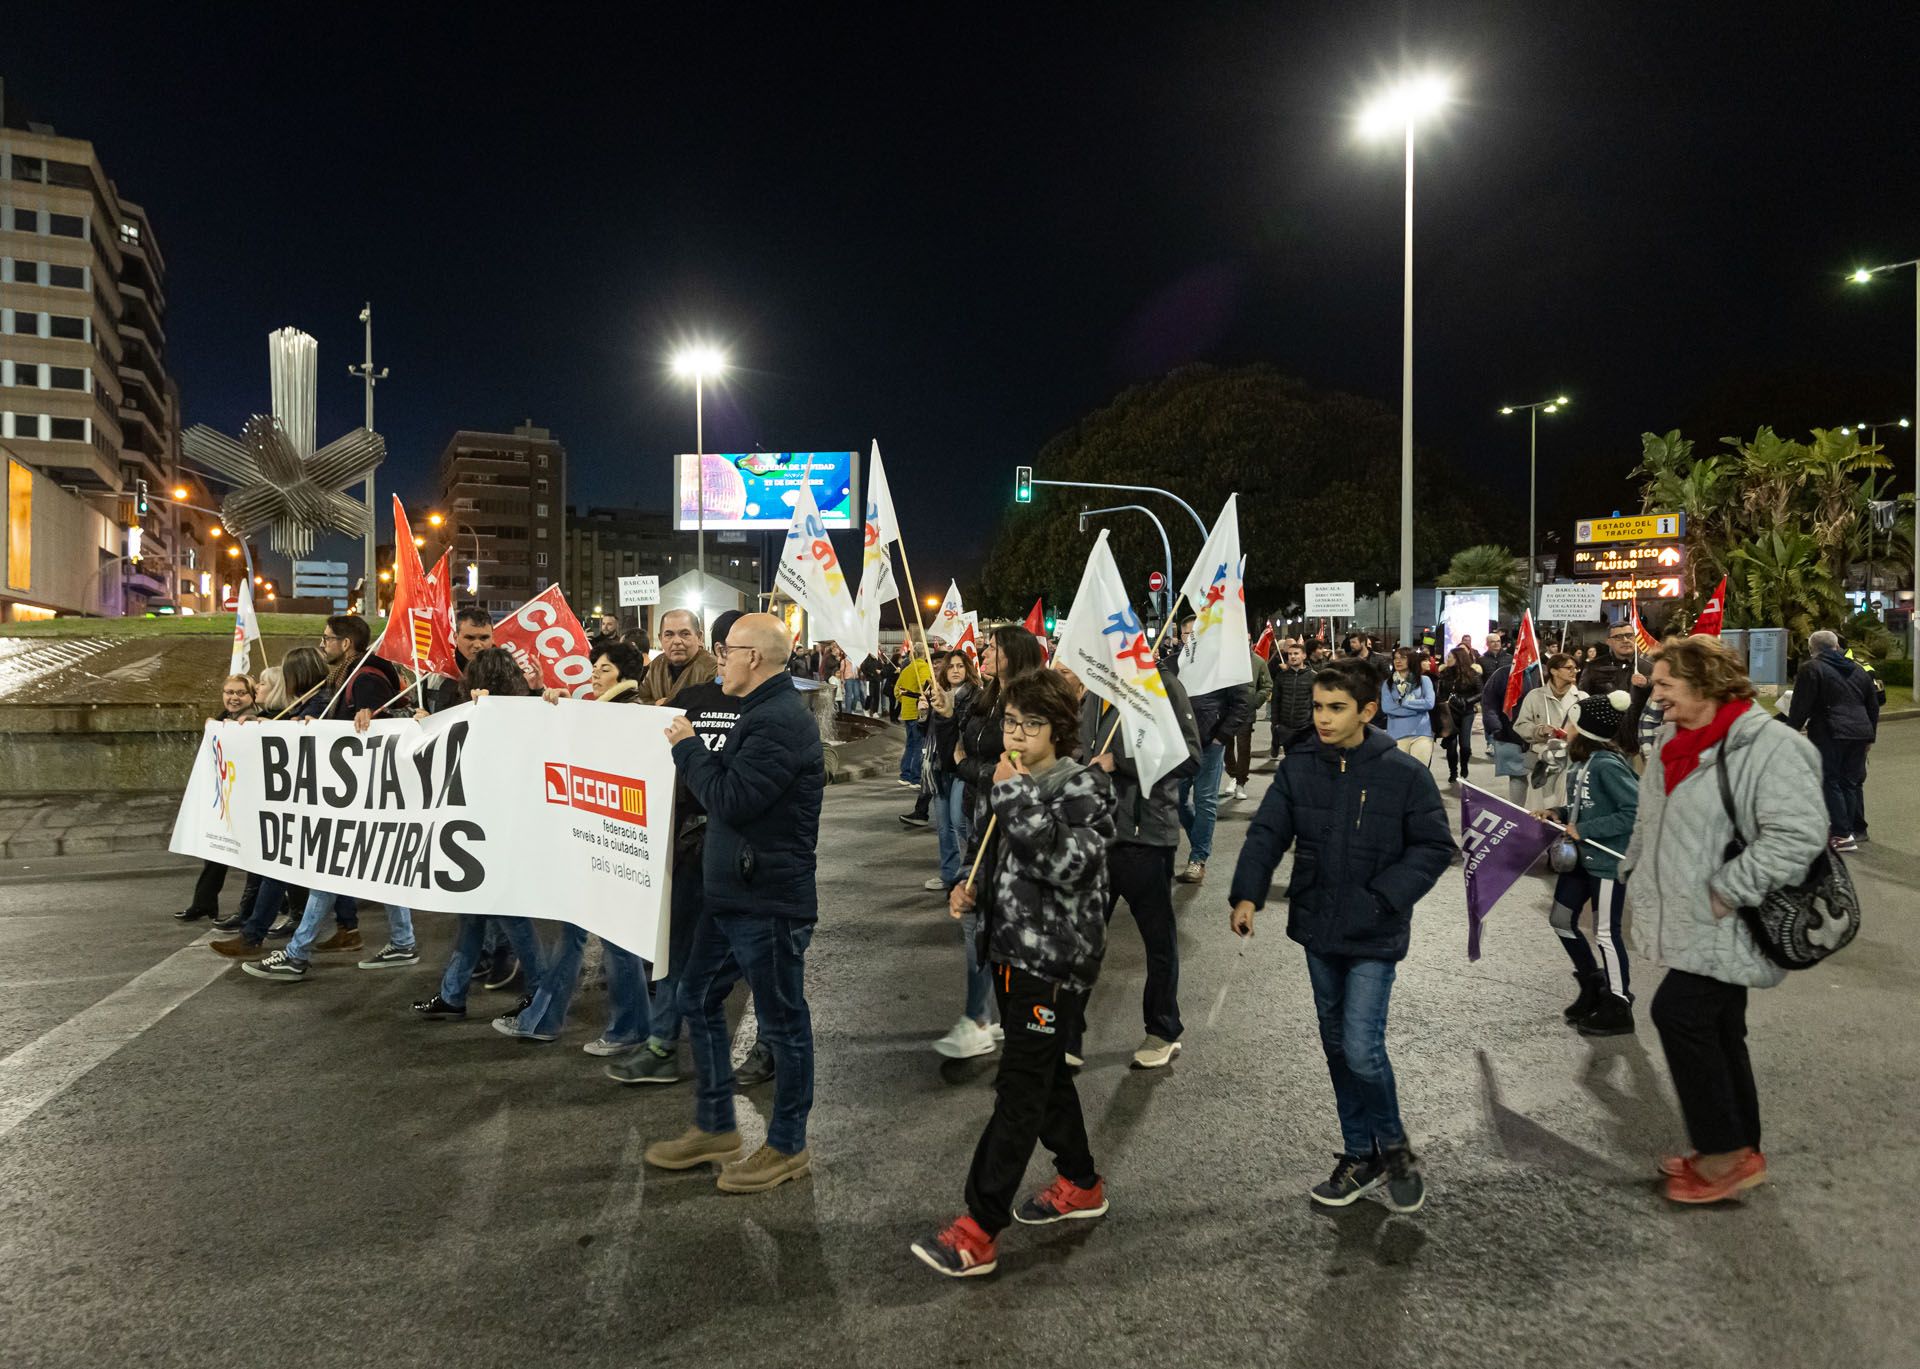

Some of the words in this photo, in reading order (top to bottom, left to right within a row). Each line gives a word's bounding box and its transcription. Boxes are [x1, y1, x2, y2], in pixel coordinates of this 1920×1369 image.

[774, 479, 785, 487] DE
[785, 479, 824, 487] DICIEBRE
[1597, 521, 1632, 530] ESTADO
[1635, 520, 1652, 528] DEL
[1605, 528, 1643, 537] TRAFICO
[1576, 552, 1595, 562] AV.
[1602, 550, 1622, 560] DR.
[1629, 549, 1659, 559] RICO
[1595, 560, 1638, 571] FLUIDO
[1602, 588, 1637, 600] LUIDO
[700, 733, 727, 752] YA
[261, 735, 405, 810] BASTA
[413, 720, 469, 810] YA
[572, 775, 621, 810] CCOO
[602, 819, 638, 841] federació
[638, 830, 649, 844] de
[259, 811, 295, 867] DE
[299, 816, 486, 892] MENTIRAS
[572, 827, 596, 844] serveis
[596, 836, 602, 845] a
[602, 835, 610, 848] la
[610, 838, 650, 860] ciutadania
[591, 856, 611, 874] país
[612, 862, 652, 887] valencià
